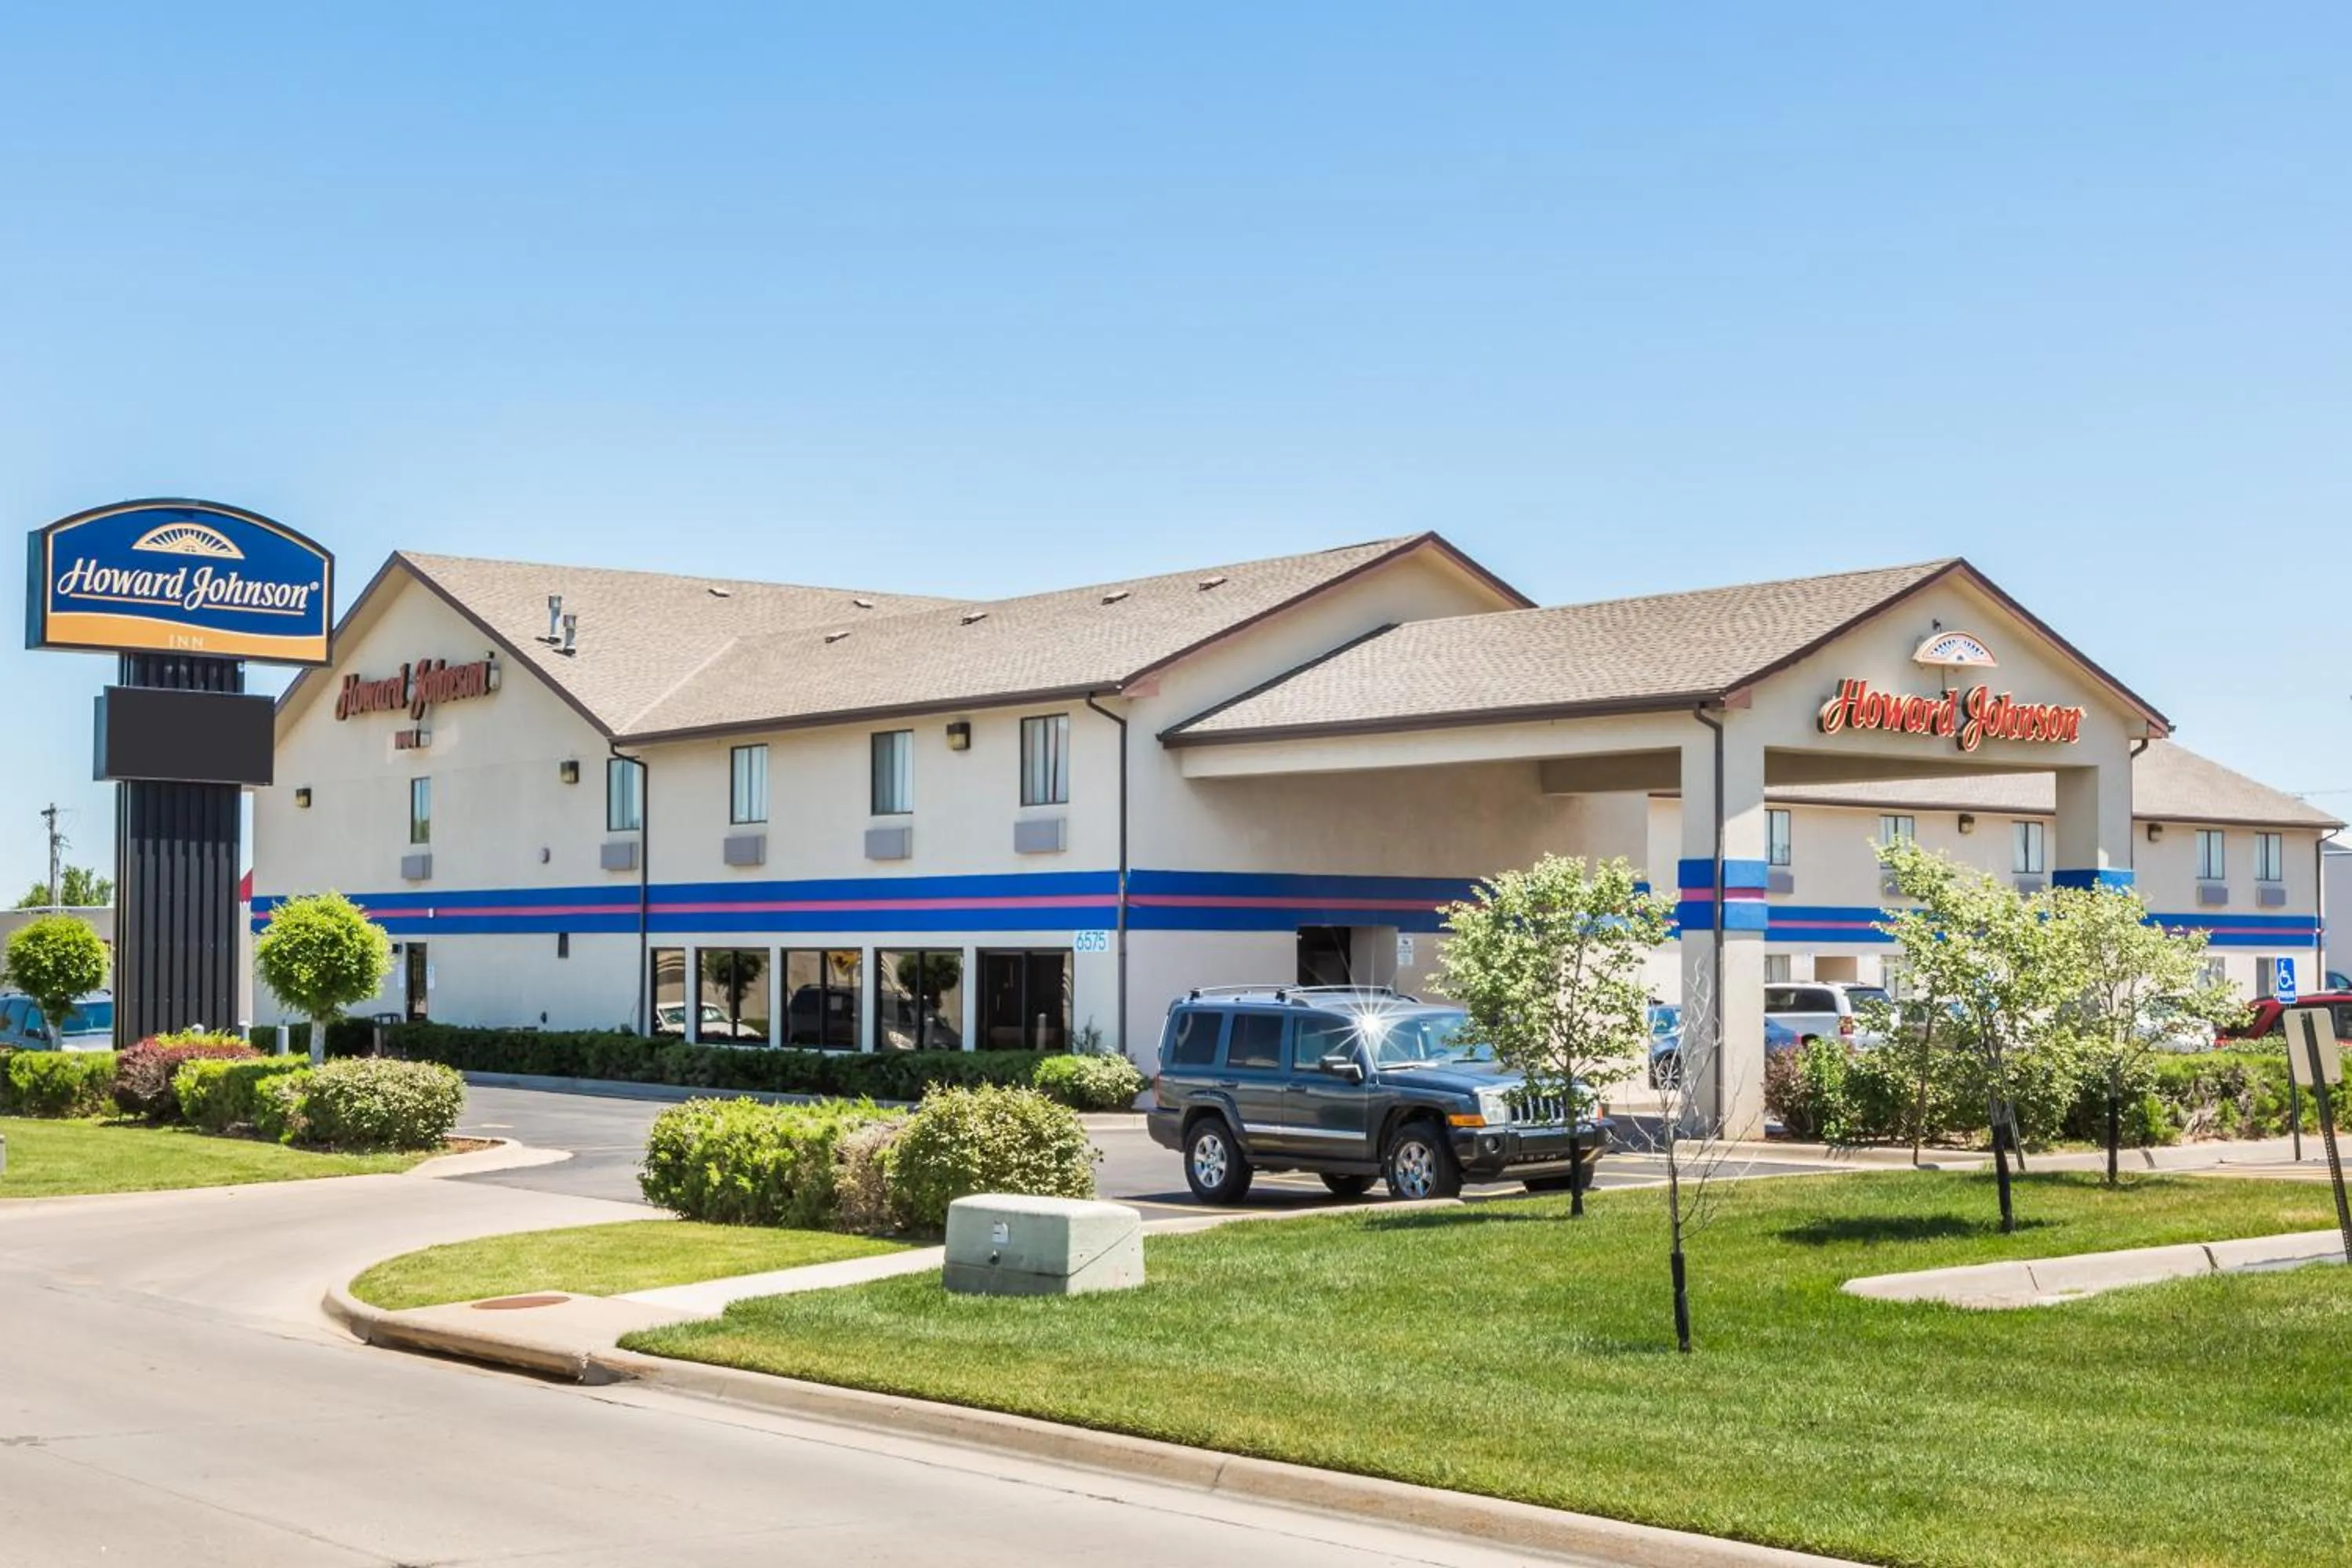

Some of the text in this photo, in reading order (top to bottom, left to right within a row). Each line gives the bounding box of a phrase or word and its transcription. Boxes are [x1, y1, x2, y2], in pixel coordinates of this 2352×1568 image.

[57, 557, 184, 599] Howard
[169, 634, 204, 650] INN
[1819, 677, 2083, 752] Howard Johnson
[1076, 931, 1106, 950] 6575
